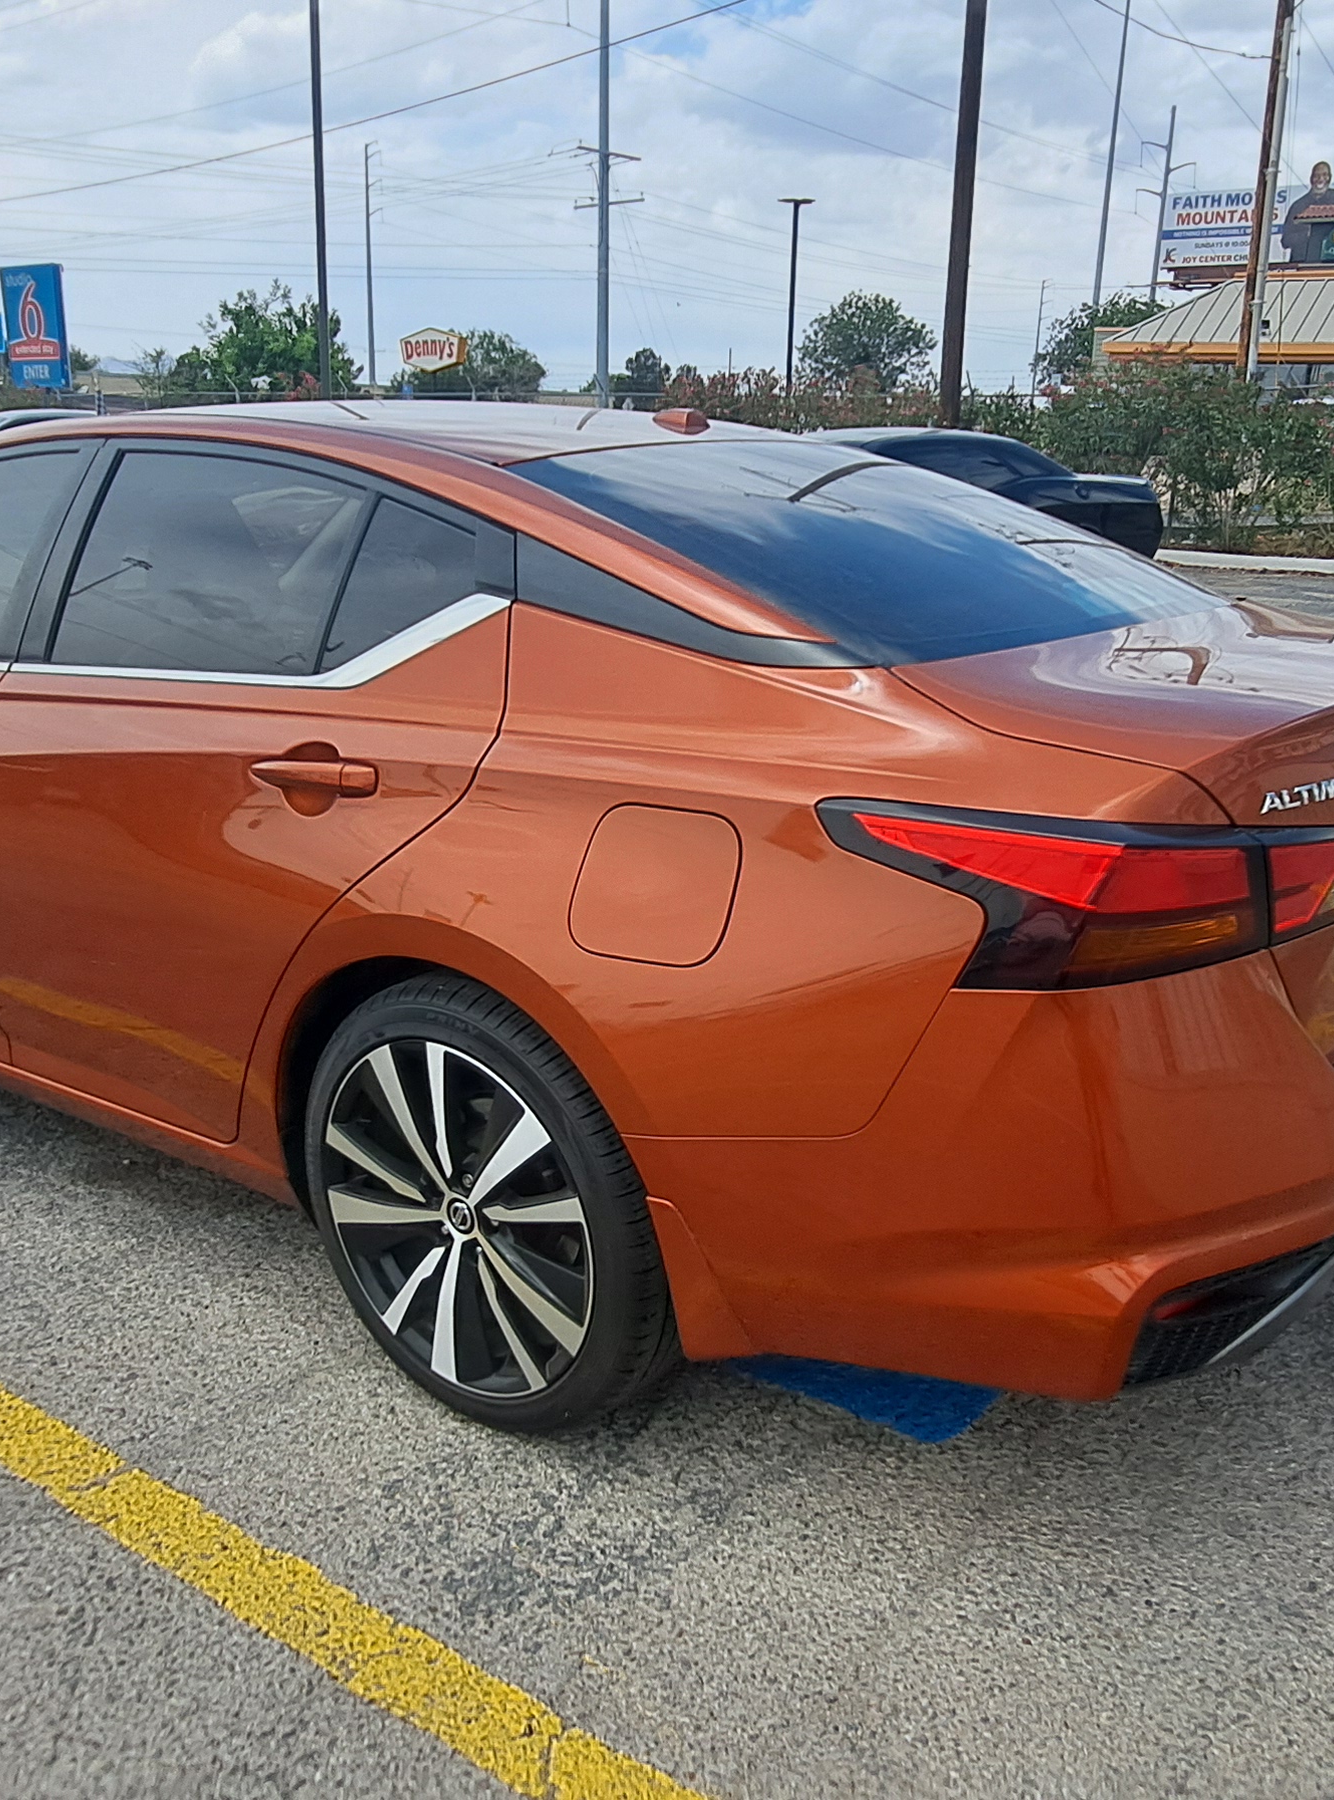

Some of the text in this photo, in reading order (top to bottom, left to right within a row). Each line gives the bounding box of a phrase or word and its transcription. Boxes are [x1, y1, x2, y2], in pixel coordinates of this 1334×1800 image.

[1172, 190, 1287, 210] FAITH MOS
[1176, 208, 1279, 226] MOUNTAS
[1194, 241, 1223, 249] SUNDAYS
[1231, 240, 1250, 248] 10:00
[1181, 256, 1198, 264] JOY
[1199, 254, 1232, 263] CENTER
[19, 281, 44, 340] 6
[404, 336, 455, 361] Denny's
[23, 364, 49, 380] ENTER
